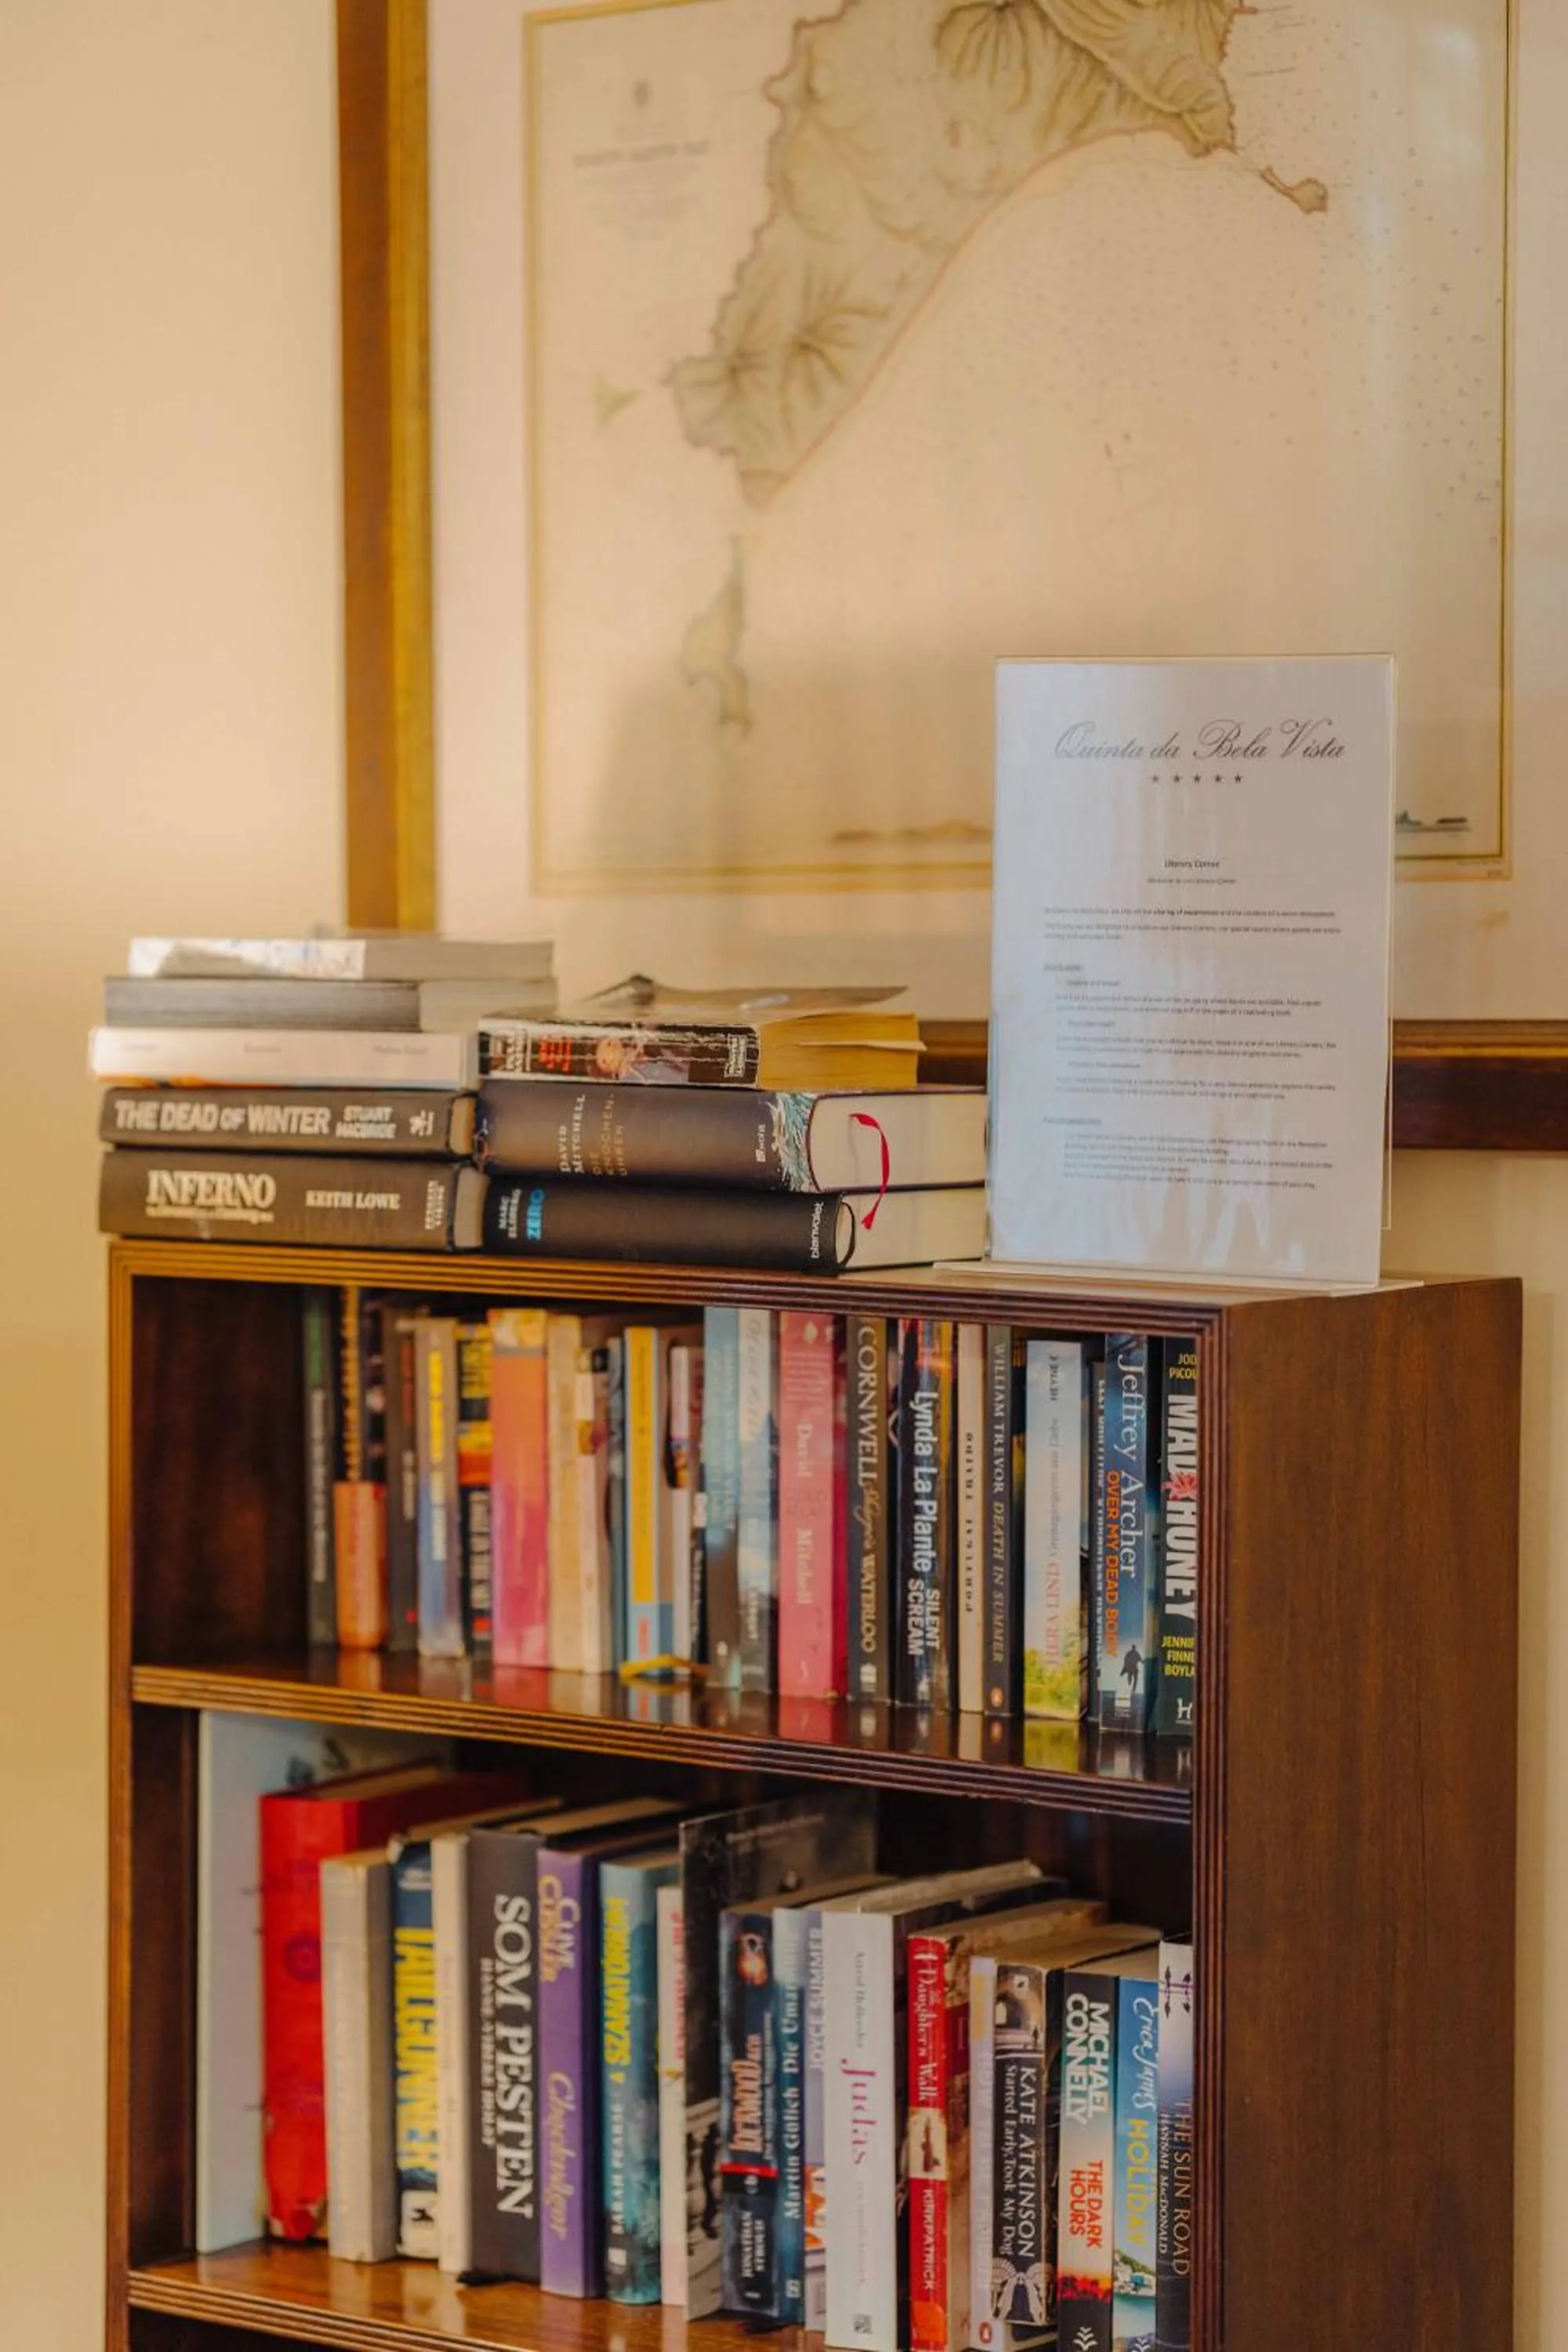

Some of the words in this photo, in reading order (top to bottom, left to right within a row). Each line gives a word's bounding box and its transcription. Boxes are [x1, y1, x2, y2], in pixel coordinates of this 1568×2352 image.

[1054, 720, 1145, 759] Quinta
[1149, 732, 1181, 759] da
[1192, 719, 1272, 759] Bela
[1279, 718, 1346, 759] Vista
[114, 1100, 158, 1130] THE
[160, 1101, 218, 1132] DEAD
[249, 1104, 331, 1134] WINTER
[572, 1093, 586, 1174] MITCHELL
[557, 1124, 571, 1172] DAVID
[147, 1170, 277, 1207] INFERNO
[306, 1190, 353, 1208] KEITH
[355, 1191, 401, 1210] LOWE
[526, 1187, 546, 1241] ZERO
[810, 1201, 825, 1259] blanvalet
[993, 1341, 1006, 1417] WILLIAM
[1168, 1367, 1198, 1380] PICOU
[1178, 1353, 1198, 1365] JOD
[857, 1326, 879, 1488] CORNWELL
[909, 1390, 939, 1457] Lynda
[1113, 1353, 1146, 1462] Jeffrey
[796, 1423, 815, 1479] David
[913, 1465, 938, 1494] La
[992, 1422, 1005, 1494] TREVOR
[1105, 1470, 1120, 1519] OVER
[1120, 1468, 1145, 1579] Archer
[912, 1498, 938, 1573] Plante
[991, 1500, 1005, 1561] DEATH
[1105, 1523, 1119, 1550] MY
[795, 1528, 814, 1605] Mitchell
[992, 1564, 1004, 1586] IN
[1044, 1562, 1060, 1609] LIND
[1105, 1554, 1120, 1603] DEAD
[860, 1552, 877, 1654] WATERLOO
[906, 1577, 925, 1656] SCREAM
[925, 1588, 941, 1651] SILENT
[991, 1590, 1004, 1664] SUMMER
[1105, 1607, 1119, 1657] BODY
[1161, 1635, 1195, 1648] JENNI
[493, 1893, 532, 2013] SOM
[394, 1926, 439, 2169] TAILGUNNER
[808, 2013, 826, 2069] JOYCE
[1133, 1996, 1160, 2051] Erica
[782, 2041, 799, 2074] Die
[918, 2062, 938, 2101] Walk
[1066, 1993, 1088, 2125] CONNELLY
[1088, 2002, 1111, 2118] MICHAEL
[1132, 2044, 1160, 2114] James
[838, 2057, 878, 2165] Judas
[1004, 2064, 1018, 2114] Started
[1019, 2067, 1036, 2125] KATE
[494, 2020, 535, 2220] PESTEN
[1160, 2113, 1170, 2170] HANNAH
[782, 2155, 801, 2220] Martin
[1004, 2158, 1018, 2191] Took
[1018, 2132, 1036, 2257] ATKINSON
[1069, 2169, 1087, 2236] HOURS
[1087, 2158, 1104, 2196] THE
[1126, 2118, 1157, 2248] HOLIDAY
[1174, 2151, 1192, 2198] SUN
[999, 2198, 1017, 2220] My
[1087, 2198, 1103, 2249] DARK
[740, 2211, 754, 2278] JONATHAN
[923, 2188, 935, 2290] KIRKPATRICK
[1000, 2226, 1017, 2256] Dog
[1173, 2209, 1192, 2276] ROAD
